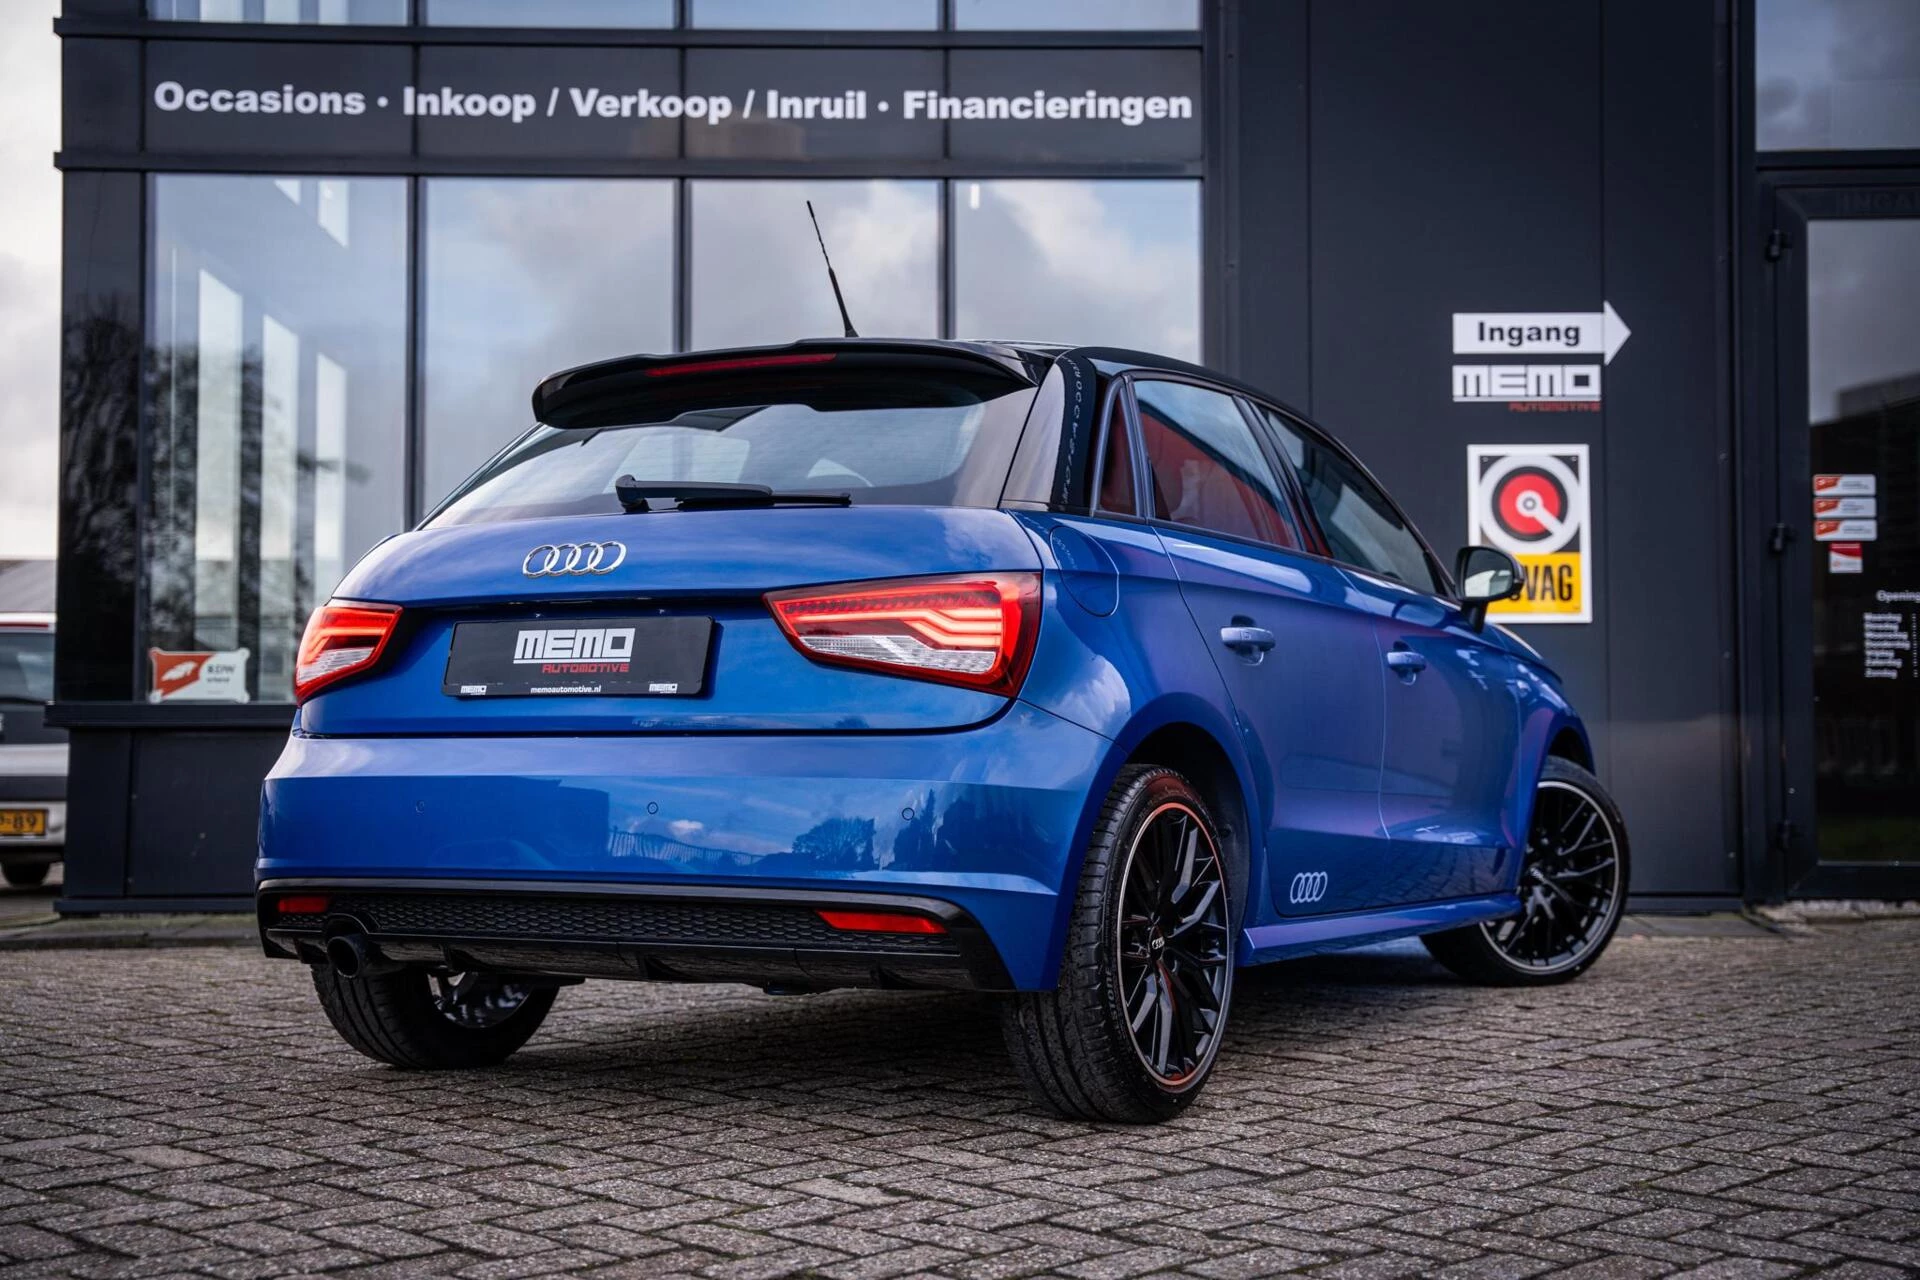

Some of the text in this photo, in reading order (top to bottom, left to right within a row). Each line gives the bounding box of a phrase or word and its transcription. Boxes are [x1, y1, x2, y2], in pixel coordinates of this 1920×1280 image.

[155, 82, 366, 115] Occasions
[404, 87, 536, 123] Inkoop
[569, 88, 733, 126] Verkoop
[767, 90, 867, 120] Inruil
[903, 90, 1192, 126] Financieringen
[1478, 321, 1580, 347] Ingang
[1452, 365, 1600, 400] MEMO
[1509, 564, 1573, 602] VAG
[513, 628, 636, 661] MEMO
[542, 663, 629, 673] AUTOMOTIVE
[530, 685, 602, 694] memoautomotive.nl
